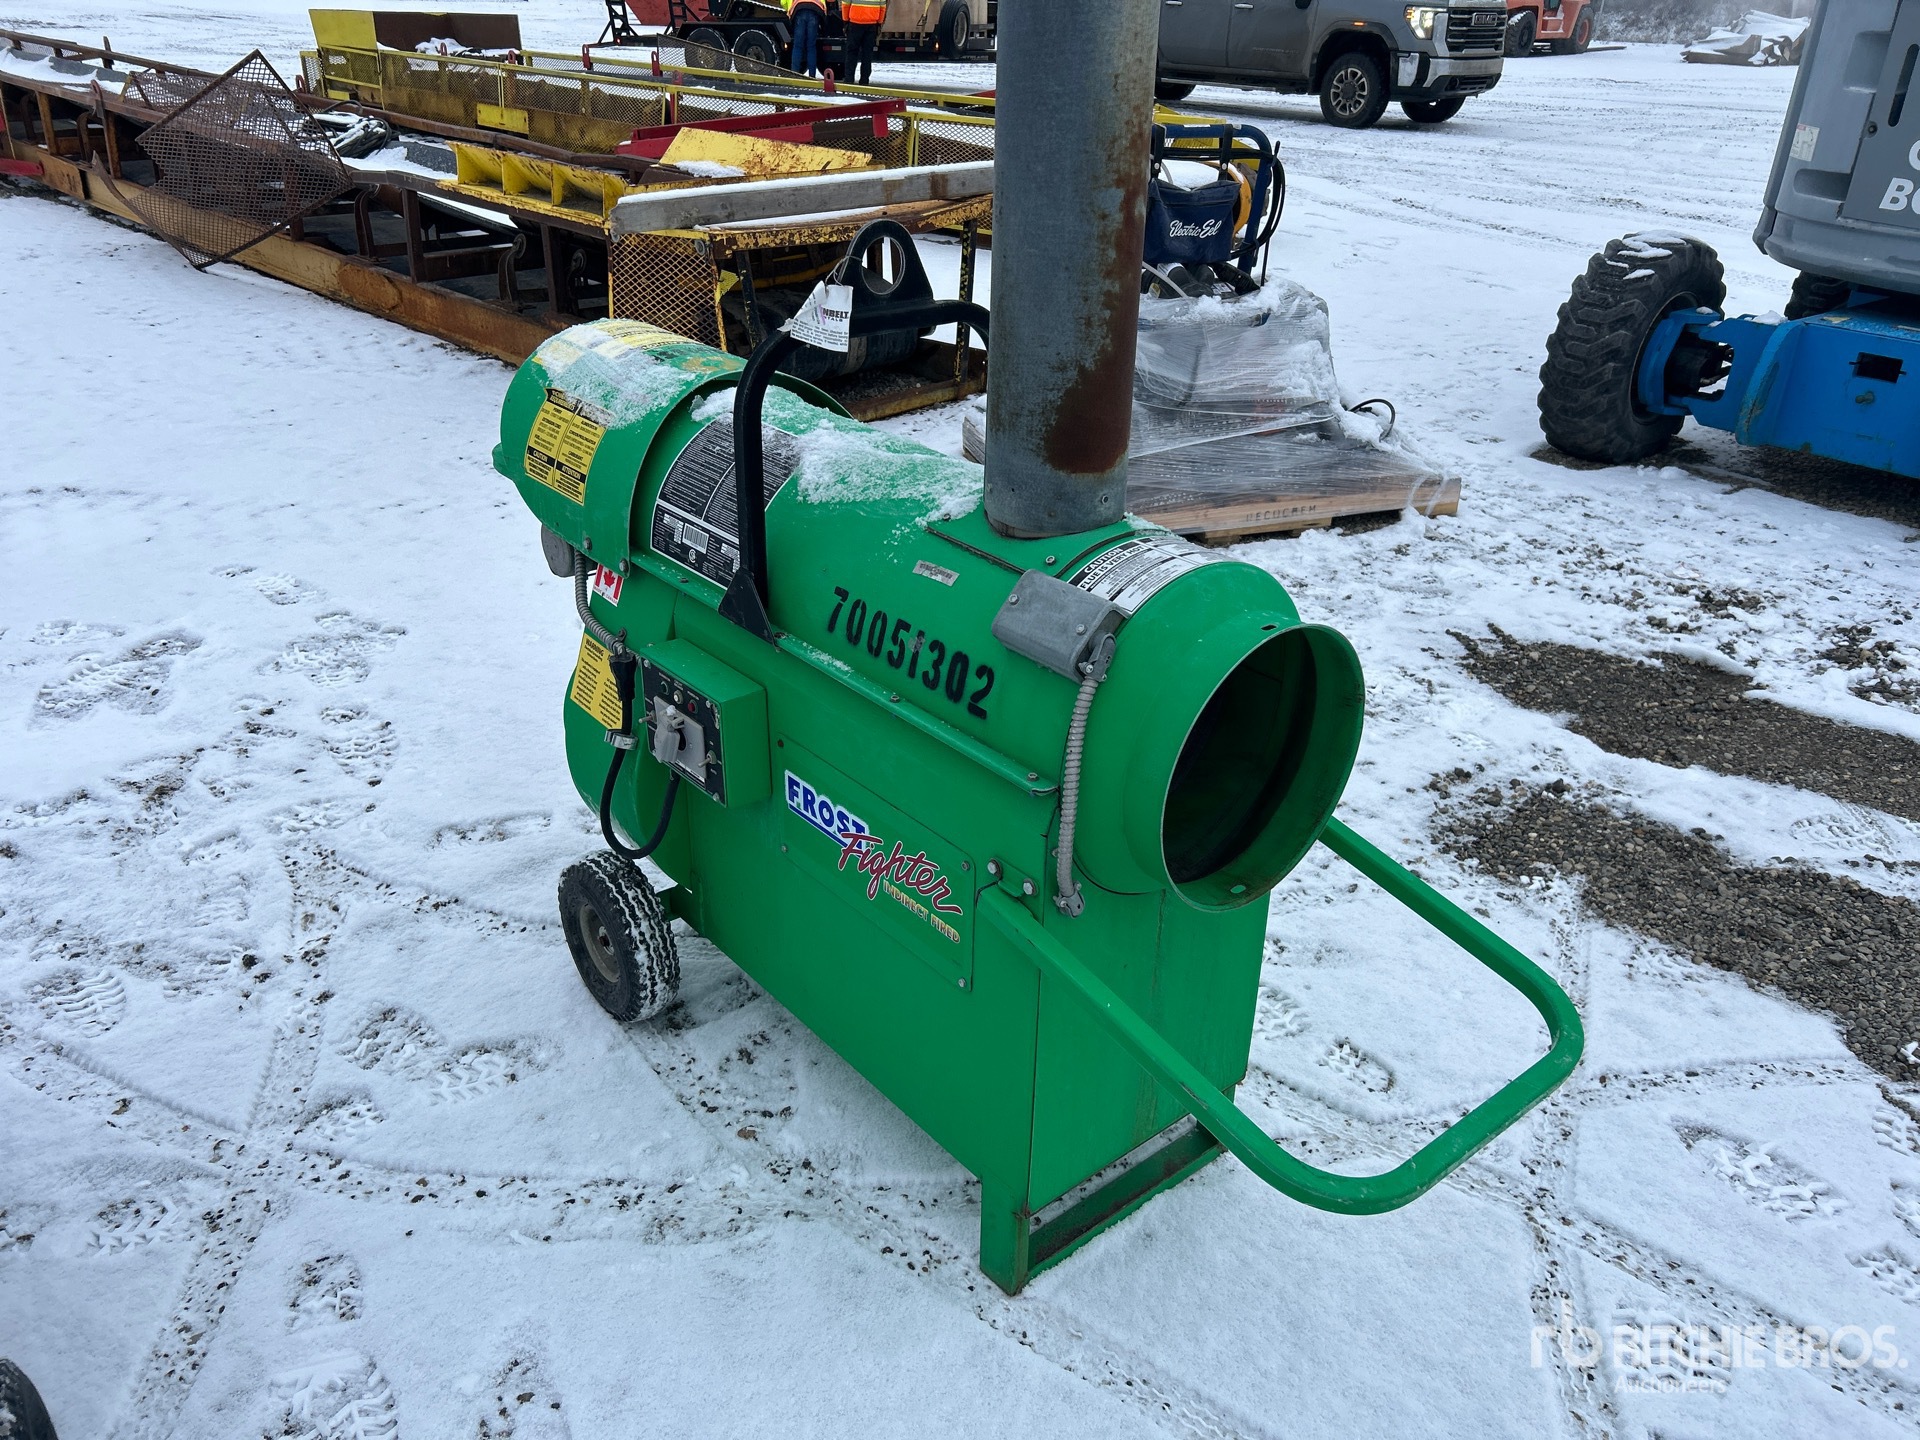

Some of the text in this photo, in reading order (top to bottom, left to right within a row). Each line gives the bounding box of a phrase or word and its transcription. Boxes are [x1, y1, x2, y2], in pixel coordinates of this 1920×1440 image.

[1169, 219, 1222, 239] Electric Eel
[1079, 571, 1100, 589] FLUE
[1106, 552, 1128, 570] VERY
[1125, 544, 1145, 559] HOT
[1084, 547, 1124, 574] CAUTION
[827, 585, 995, 720] 70051302
[787, 774, 868, 850] FROST
[838, 831, 963, 915] Fighter
[883, 879, 961, 944] INDIRECT FIRED
